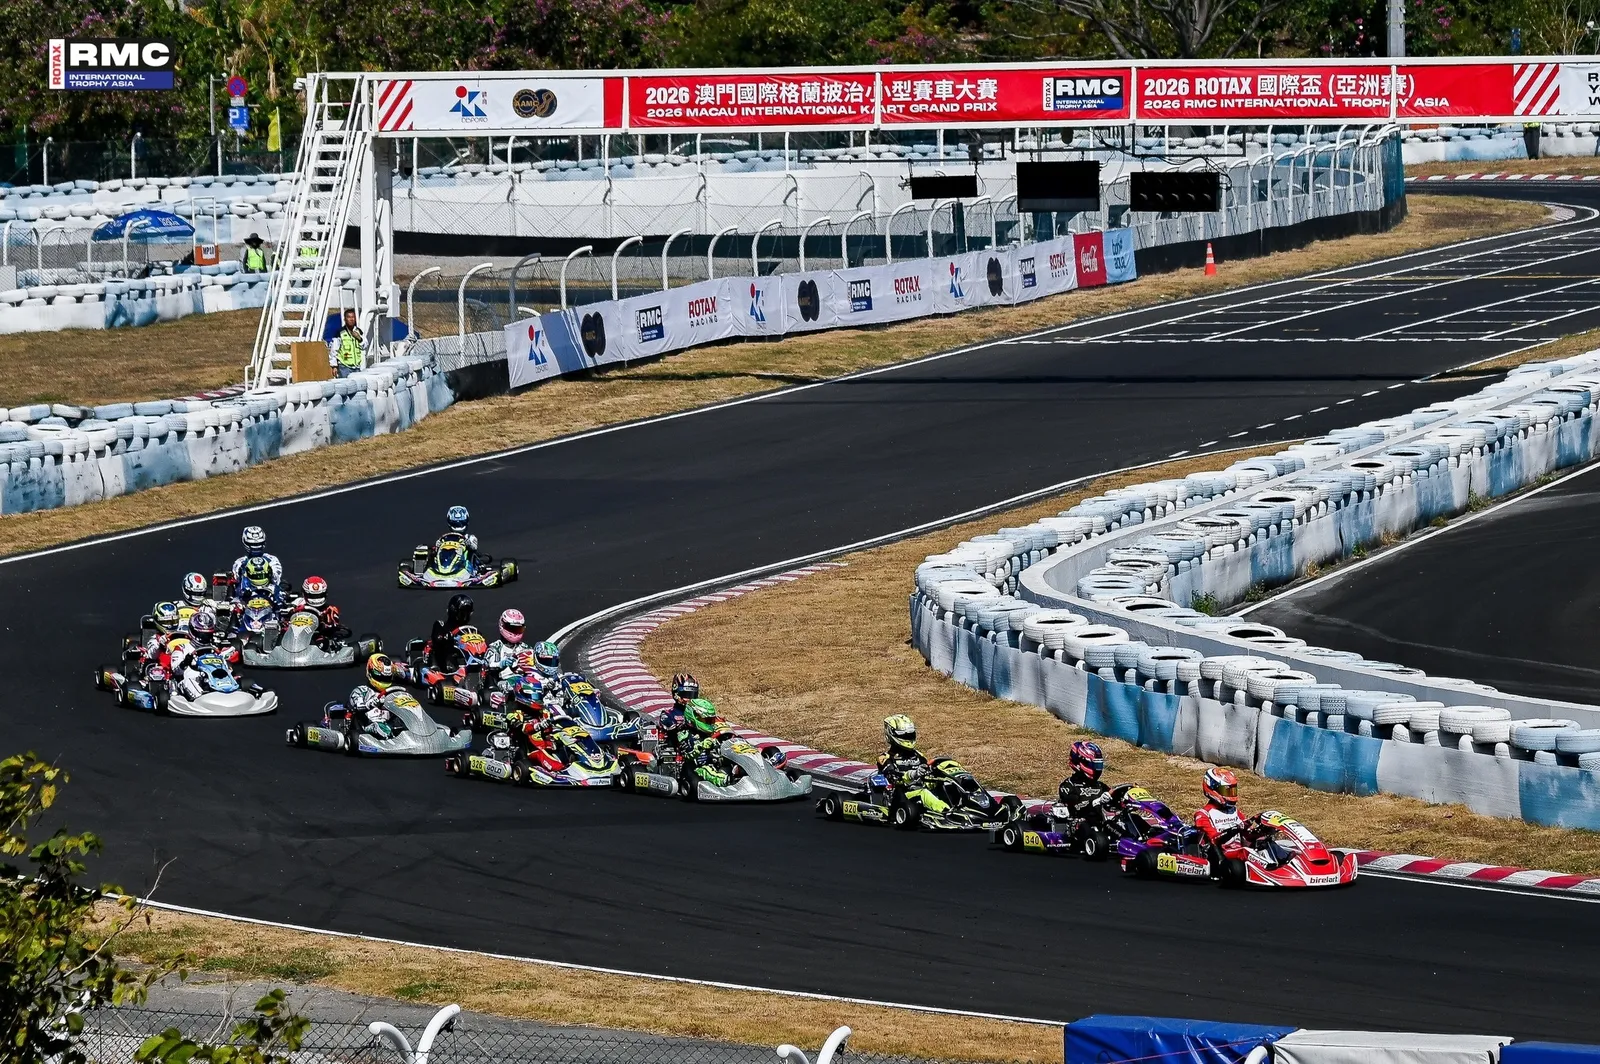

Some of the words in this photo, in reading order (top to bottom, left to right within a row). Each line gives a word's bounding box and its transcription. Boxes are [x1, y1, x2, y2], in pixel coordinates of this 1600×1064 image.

[645, 87, 690, 105] 2026
[694, 78, 998, 105] 澳門國際格蘭披治小型賽車大賽
[1056, 78, 1121, 96] RMC
[1144, 78, 1189, 96] 2026
[1195, 77, 1252, 95] ROTAX
[646, 109, 682, 118] 2026
[686, 107, 738, 117] MACAU
[741, 105, 856, 116] INTERNATIONAL
[860, 104, 905, 114] KART
[909, 103, 960, 113] GRAND
[963, 102, 998, 112] PRIX
[1143, 100, 1181, 109] 2026
[1184, 99, 1217, 109] RMC
[1220, 98, 1338, 108] INTERNATIONAL
[1342, 98, 1409, 107] TROPHY
[1414, 97, 1450, 107] ASIA
[229, 108, 239, 124] P
[851, 281, 871, 299] RMC
[894, 275, 920, 295] ROTAX
[896, 293, 922, 304] RACING
[688, 296, 717, 319] ROTAX
[640, 308, 661, 328] RMC
[690, 314, 718, 329] RACING
[471, 760, 483, 770] 326
[844, 803, 857, 814] 320
[1025, 835, 1040, 846] 340
[1158, 858, 1175, 869] 341
[1177, 864, 1207, 876] birelart
[1309, 875, 1339, 884] birelart
